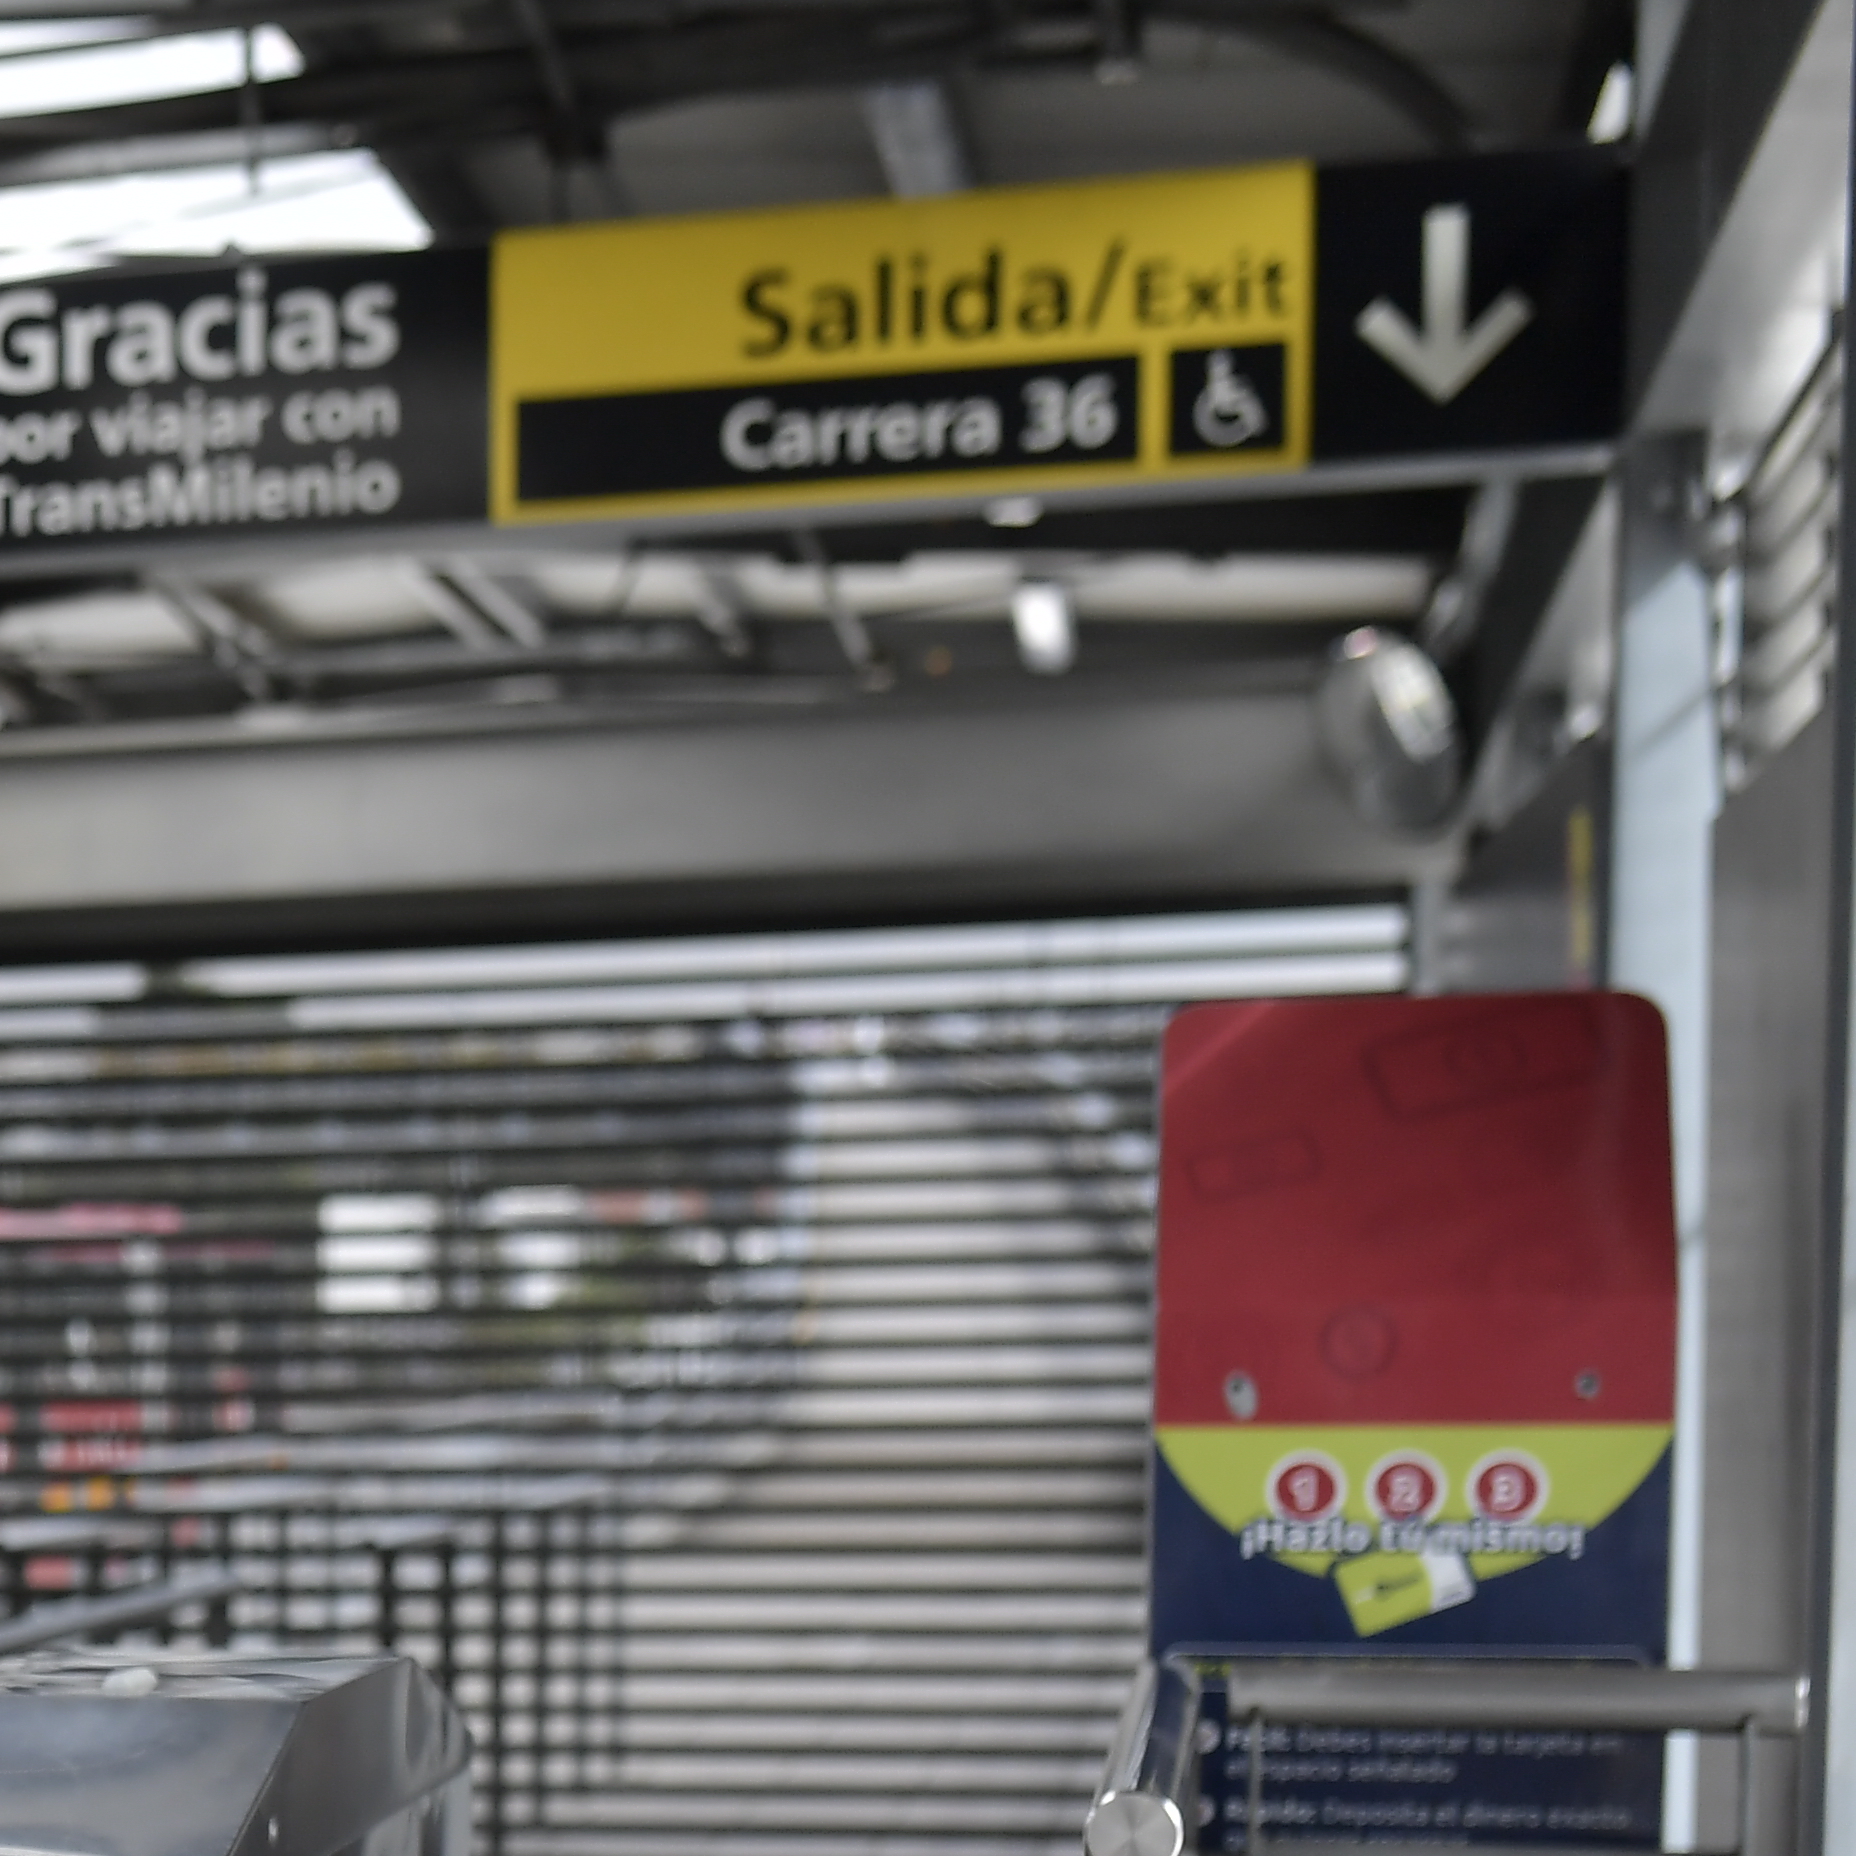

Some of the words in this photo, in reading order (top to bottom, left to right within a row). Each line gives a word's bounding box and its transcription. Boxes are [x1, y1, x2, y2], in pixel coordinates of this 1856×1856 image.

[89, 391, 272, 463] viajar
[281, 385, 401, 443] con
[720, 398, 1004, 474] Carrera
[1020, 373, 1118, 458] 36
